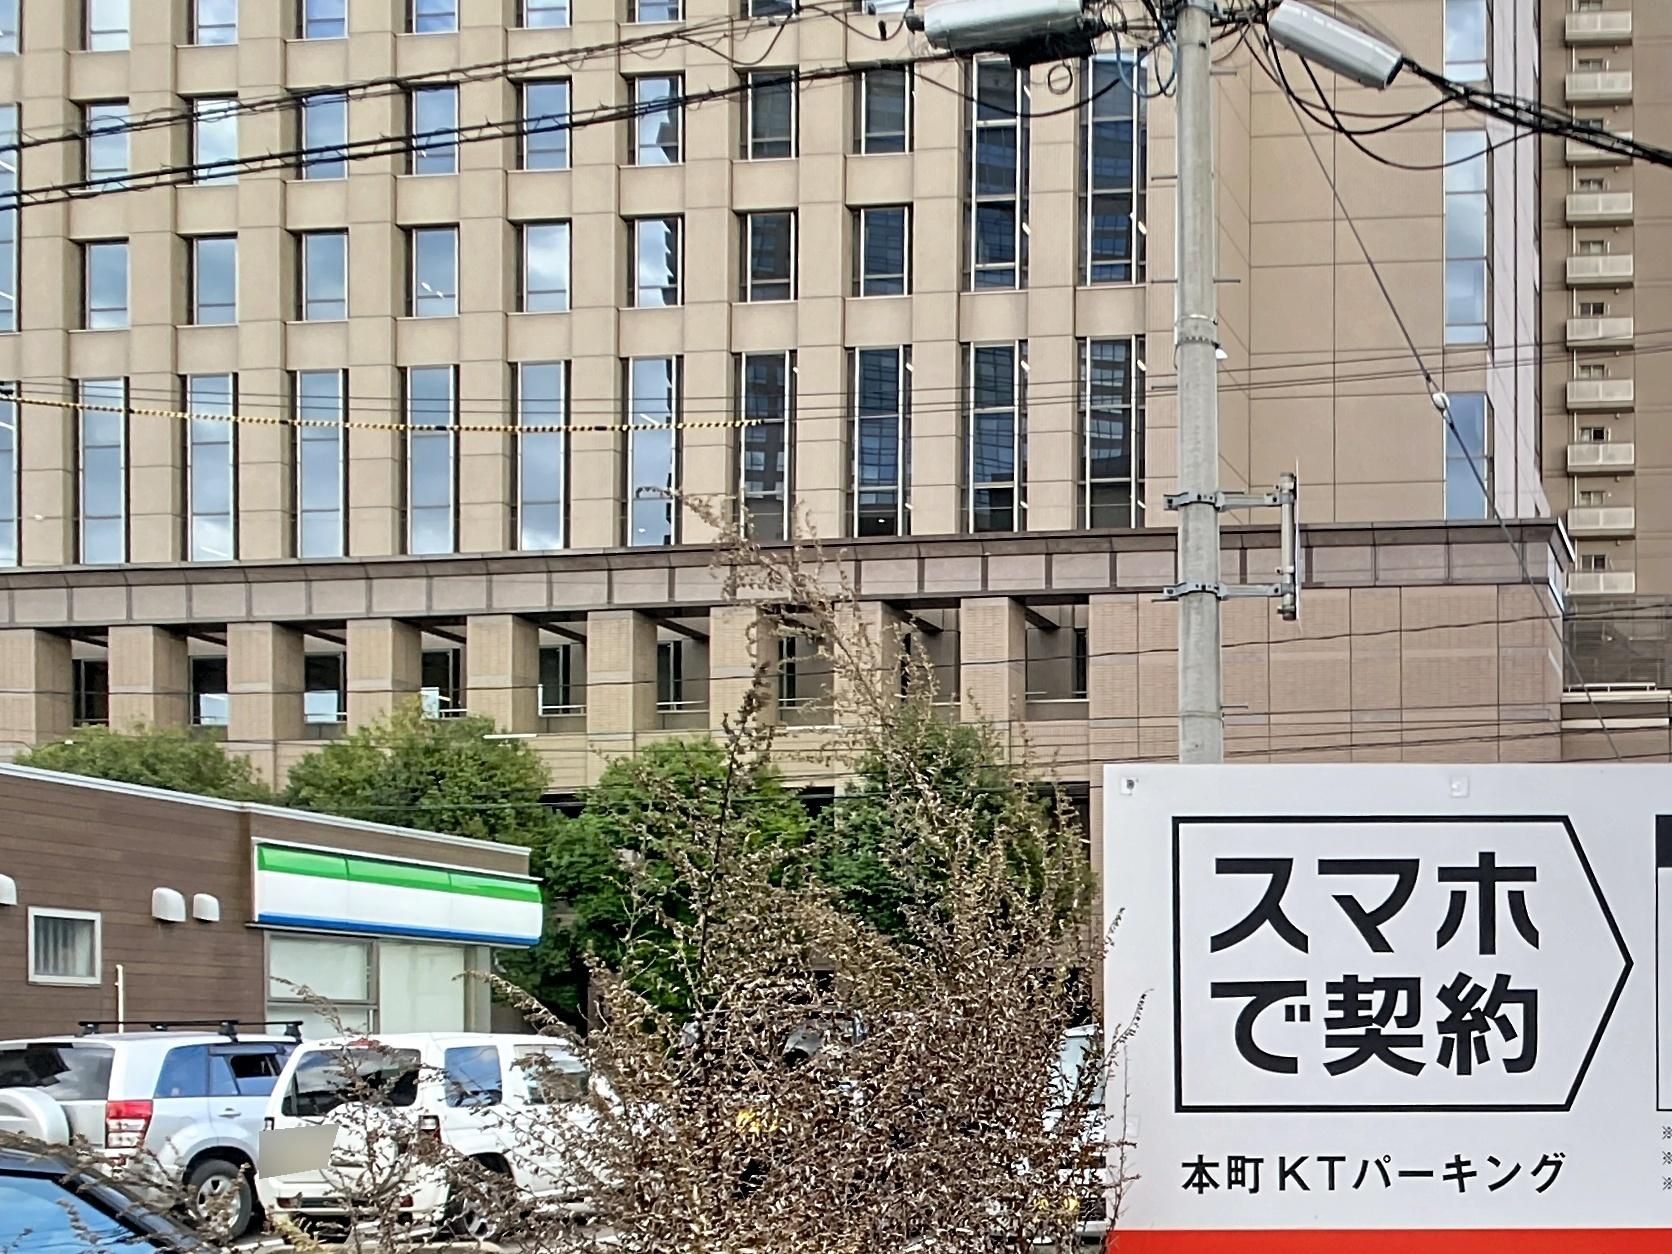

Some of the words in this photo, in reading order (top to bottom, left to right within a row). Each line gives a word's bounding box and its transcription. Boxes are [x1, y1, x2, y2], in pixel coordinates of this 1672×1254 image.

[1210, 851, 1540, 955] スマホ
[1210, 971, 1539, 1077] で契約
